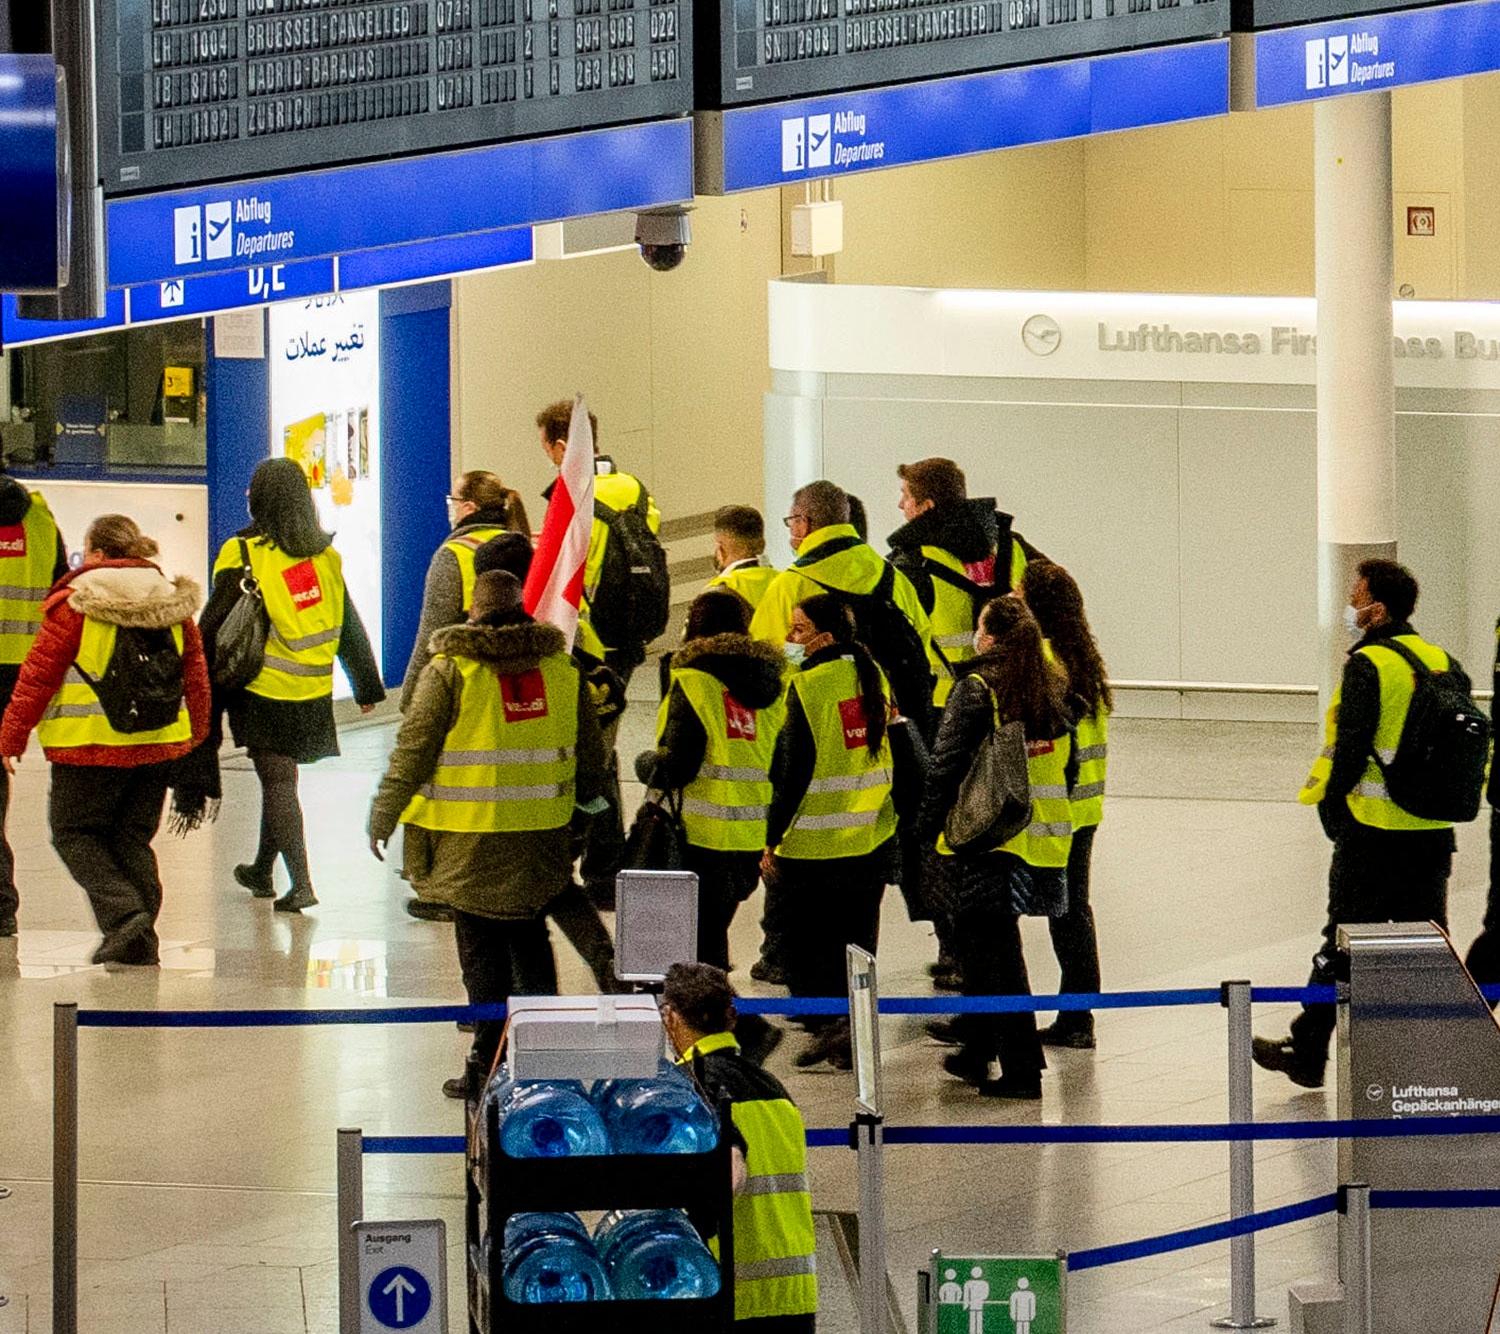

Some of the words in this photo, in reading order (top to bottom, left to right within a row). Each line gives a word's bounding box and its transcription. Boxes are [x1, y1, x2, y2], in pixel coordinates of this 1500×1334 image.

[1349, 31, 1379, 55] Abflug
[1350, 59, 1395, 86] Departures
[833, 111, 867, 135] Abflug
[833, 139, 886, 166] Departures
[235, 197, 272, 225] Abflug
[235, 229, 296, 258] Departures
[1097, 321, 1262, 357] Lufthansa
[1391, 1084, 1459, 1100] Lufthansa
[364, 1233, 412, 1245] Ausgang
